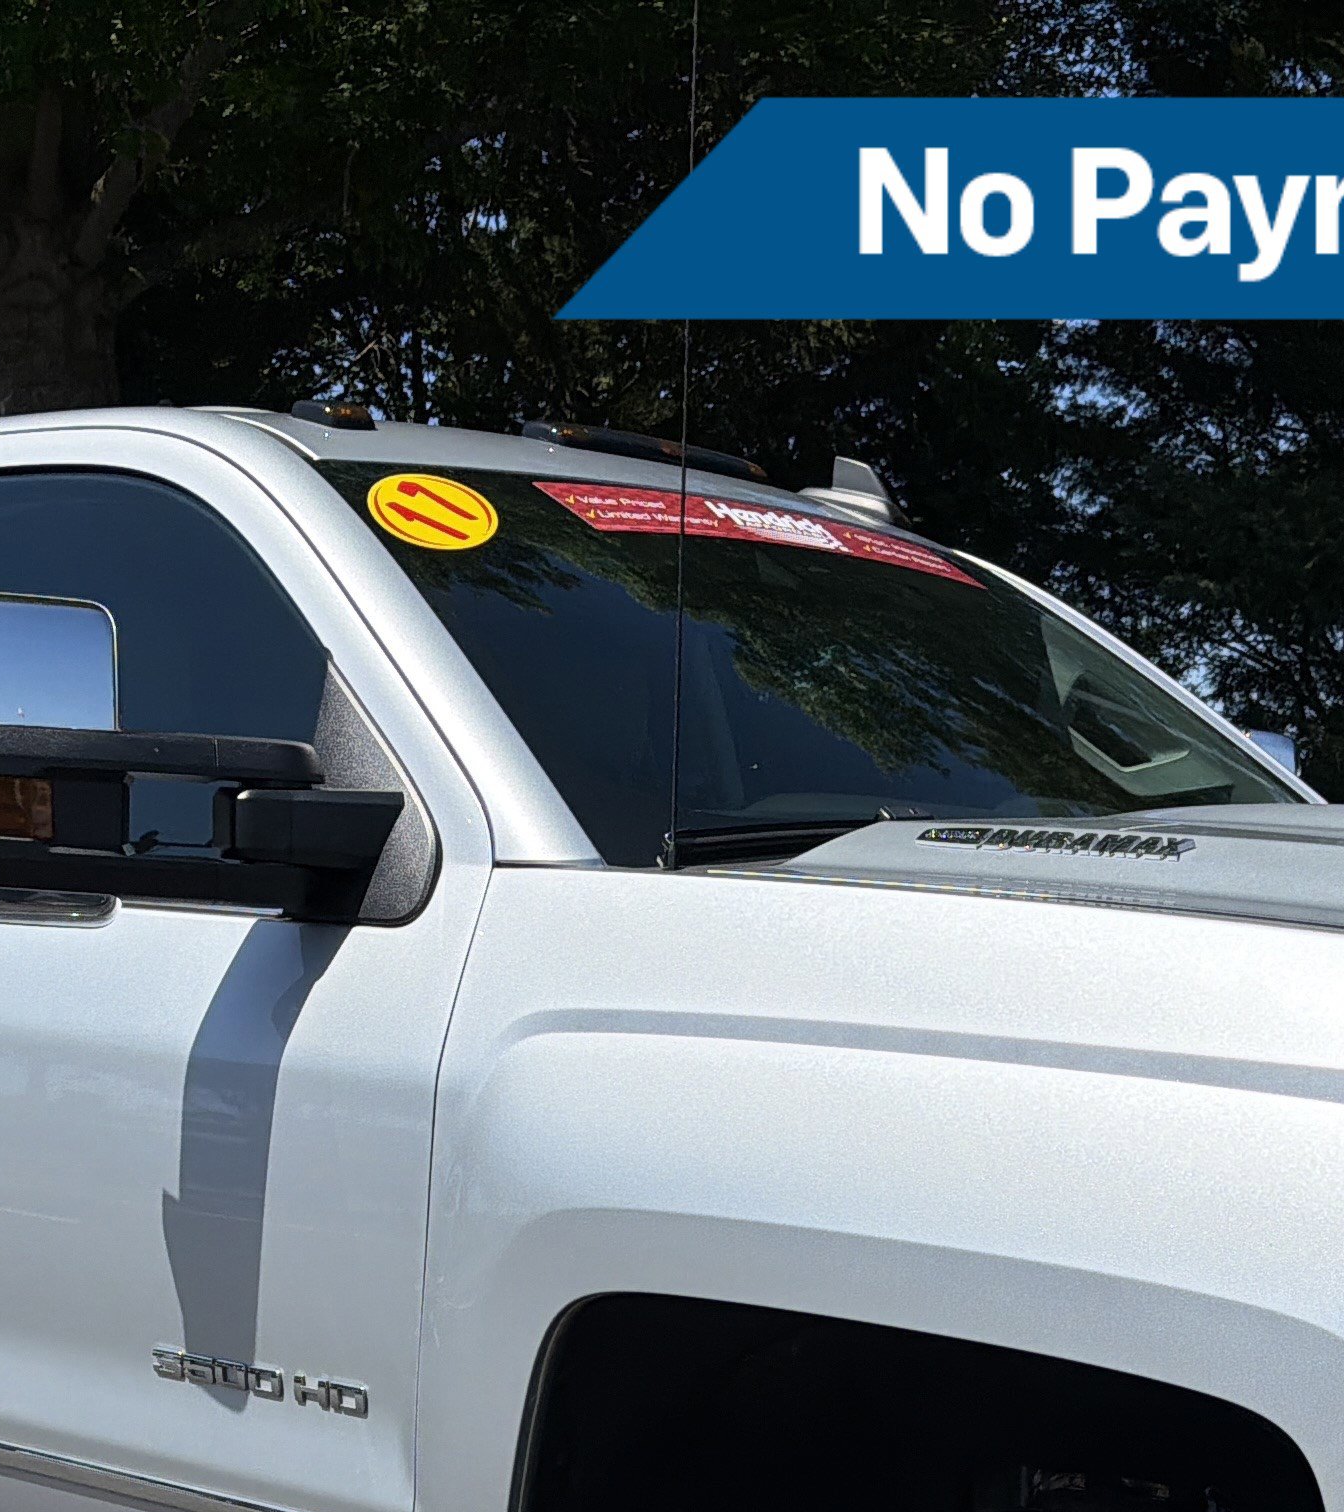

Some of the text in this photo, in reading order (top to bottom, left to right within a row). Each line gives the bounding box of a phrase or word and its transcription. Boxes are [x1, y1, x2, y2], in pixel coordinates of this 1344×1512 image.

[575, 495, 666, 510] Value Priced
[596, 510, 719, 528] Limited Waranty
[704, 500, 834, 542] Hendrick
[982, 828, 1196, 861] DURAMAX
[152, 1345, 369, 1419] 3500 HD
